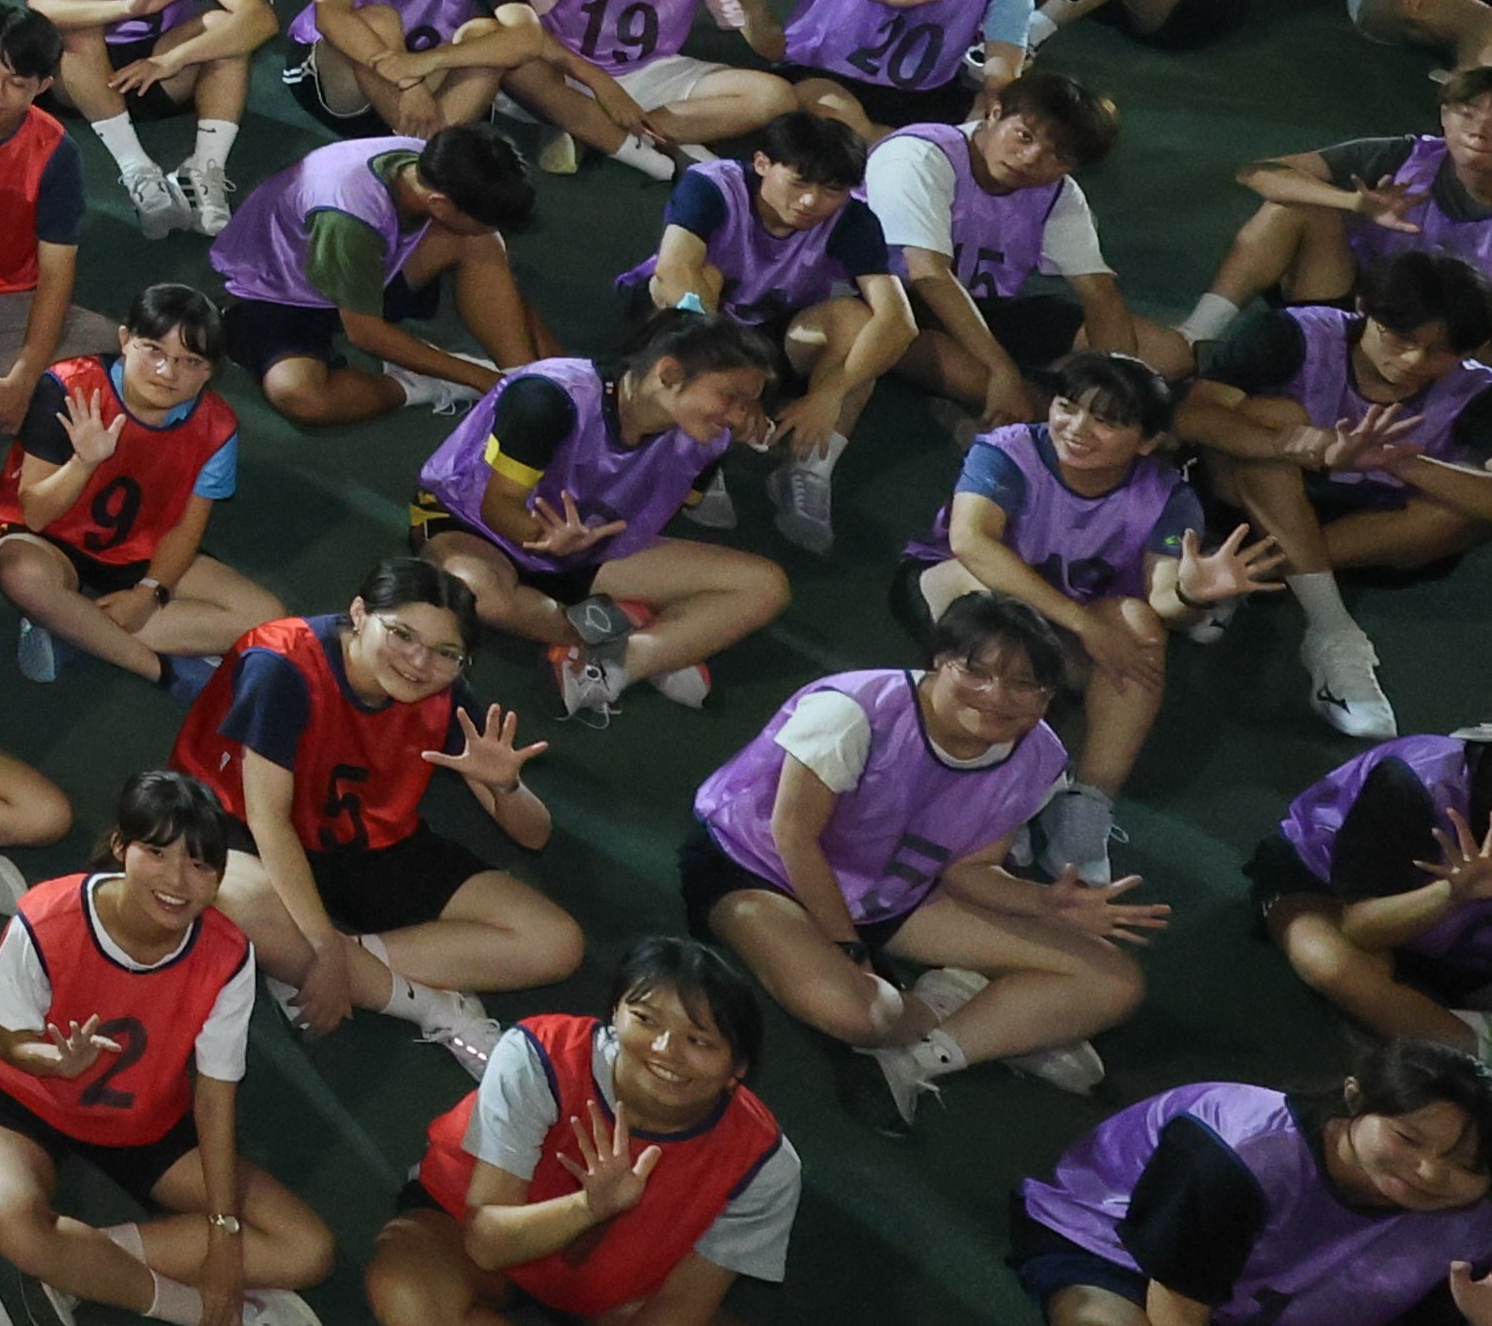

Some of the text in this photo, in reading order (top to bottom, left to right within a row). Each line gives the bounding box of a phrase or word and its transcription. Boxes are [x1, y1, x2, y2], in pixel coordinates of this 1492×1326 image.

[846, 16, 945, 88] 20
[84, 475, 141, 551] 9
[319, 764, 370, 853] 5
[81, 1018, 150, 1109] 2
